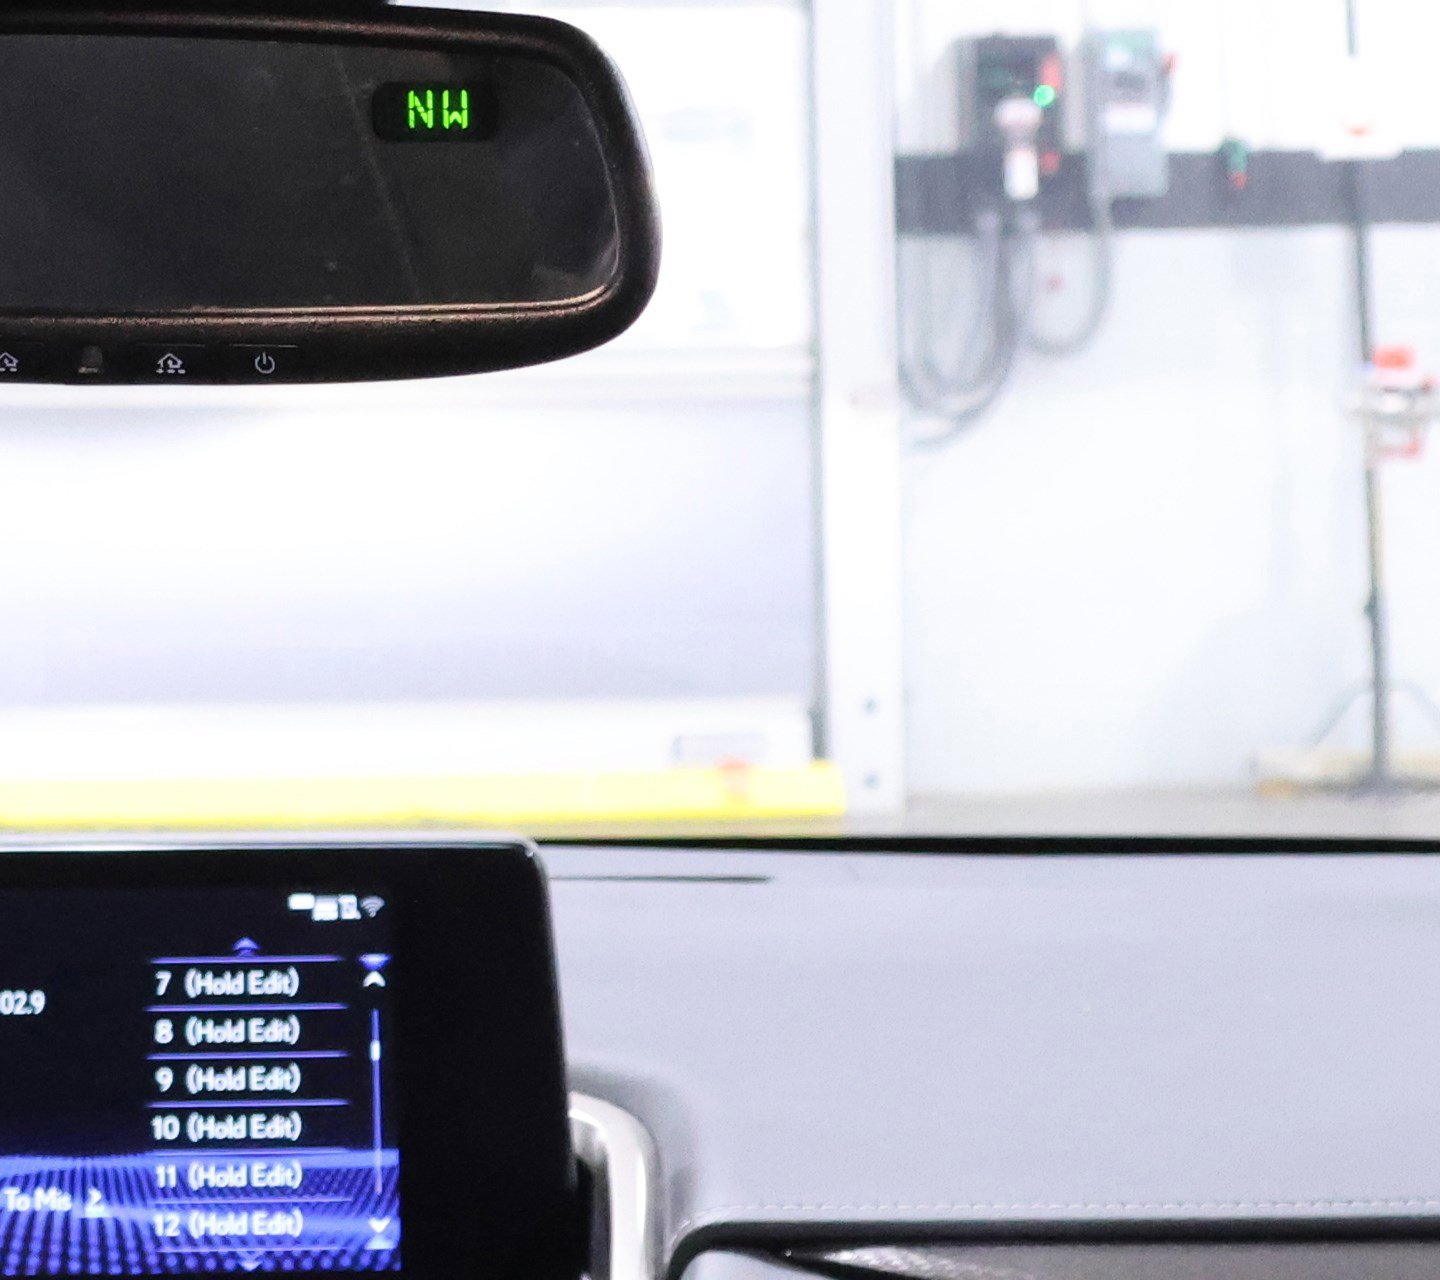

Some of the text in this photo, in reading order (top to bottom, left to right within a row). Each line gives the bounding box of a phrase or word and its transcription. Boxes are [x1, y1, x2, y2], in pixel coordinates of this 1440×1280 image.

[407, 88, 469, 130] NW
[155, 965, 300, 999] 7 (Hold Edit)
[154, 1013, 301, 1047] 8 (Hold Edit)
[155, 1061, 301, 1095] 9 (Hold Edit)
[151, 1110, 302, 1143] 10 (Hold Edit)
[155, 1159, 303, 1191] 11 (Hold Edit)
[3, 1186, 32, 1213] To
[154, 1207, 304, 1240] 12 (Hold Edit)
